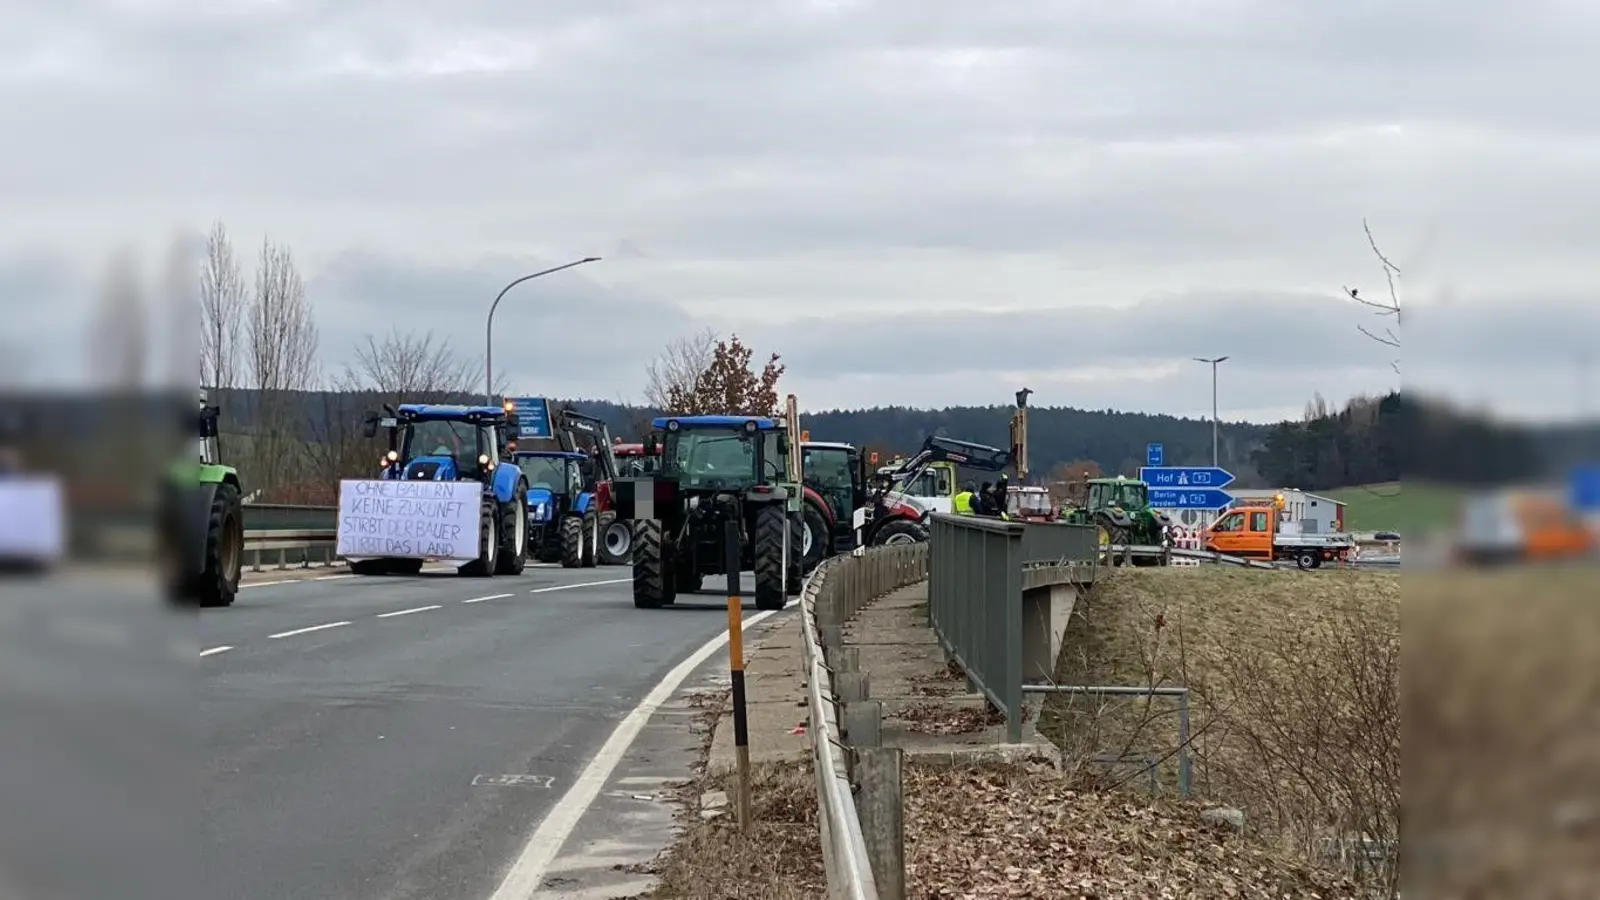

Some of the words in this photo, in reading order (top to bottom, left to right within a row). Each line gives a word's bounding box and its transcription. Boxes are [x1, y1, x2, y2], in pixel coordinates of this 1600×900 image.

[1156, 473, 1174, 482] Hof
[355, 481, 391, 496] OHNE
[396, 482, 454, 498] BAUERN
[351, 497, 395, 515] KEINE
[397, 499, 466, 519] ZUKUNFT
[343, 516, 385, 535] STIRBT
[387, 518, 413, 536] DER
[416, 521, 461, 541] BAUER
[342, 535, 383, 553] STIRBT
[385, 538, 412, 554] DAS
[417, 540, 455, 556] LAND
